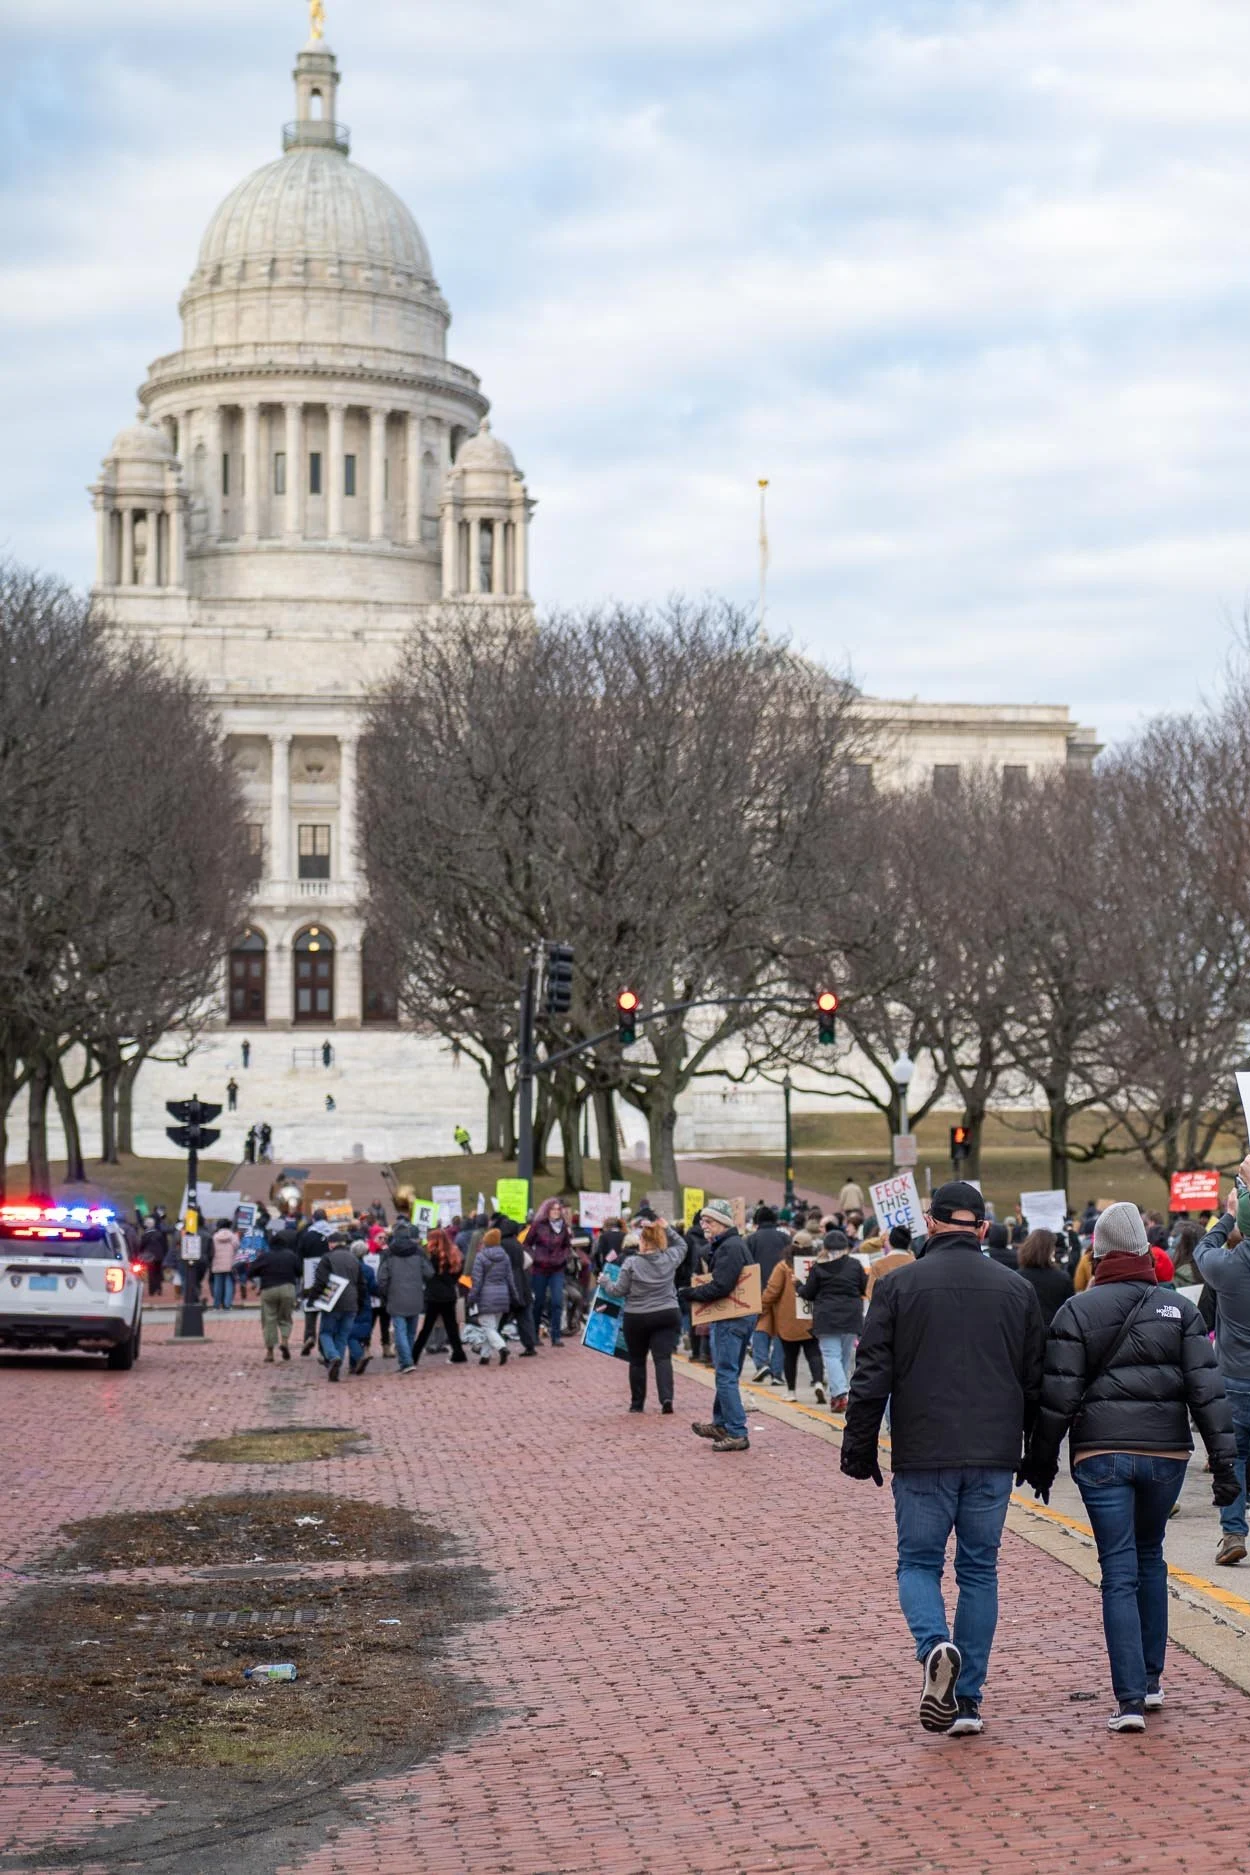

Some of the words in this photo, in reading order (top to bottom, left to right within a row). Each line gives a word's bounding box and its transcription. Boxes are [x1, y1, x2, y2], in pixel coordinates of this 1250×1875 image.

[875, 1176, 911, 1200] FECK
[877, 1192, 910, 1213] THIS
[884, 1206, 915, 1229] ICE
